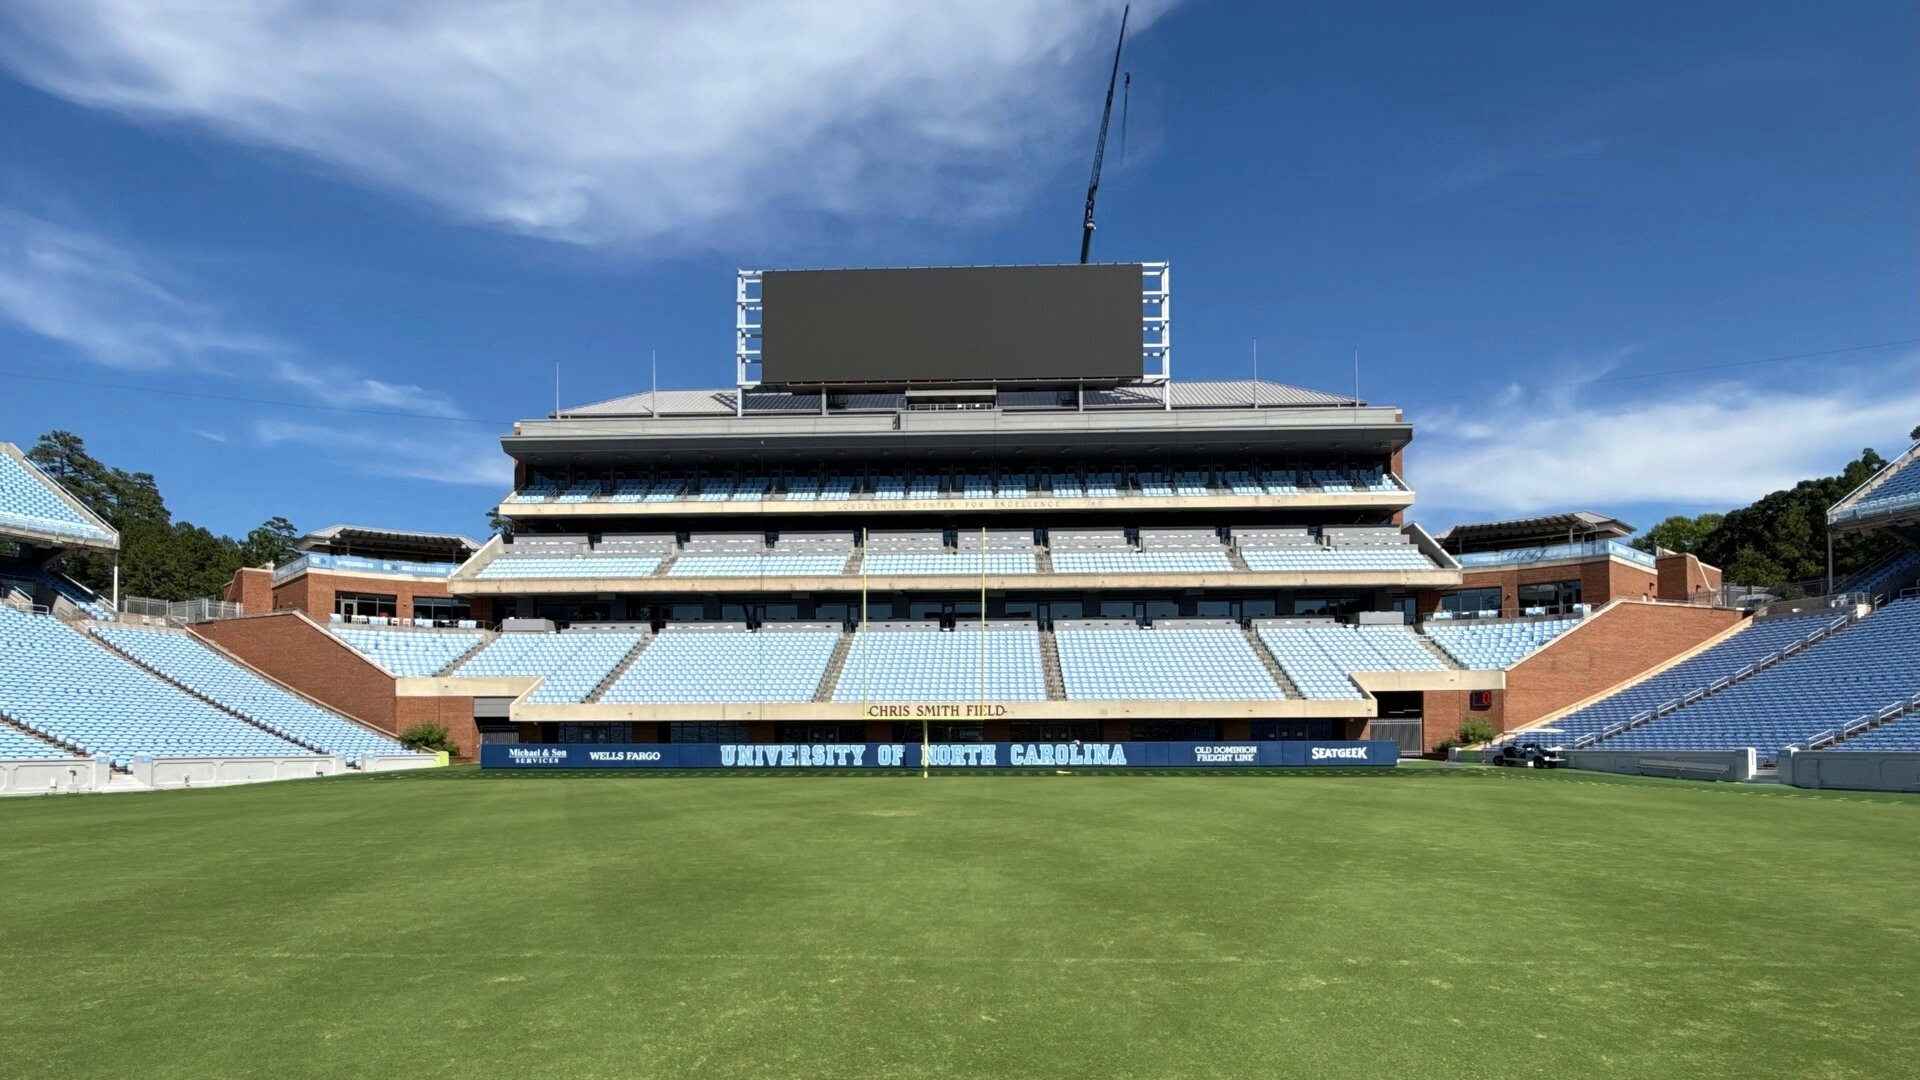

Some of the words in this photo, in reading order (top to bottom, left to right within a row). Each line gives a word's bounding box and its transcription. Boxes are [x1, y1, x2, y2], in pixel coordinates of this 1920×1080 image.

[869, 705, 910, 717] CHRIS
[916, 705, 960, 717] SMITH
[966, 705, 1005, 717] FIELD
[509, 748, 541, 757] Michael
[542, 749, 550, 757] &
[551, 749, 567, 757] Son
[1194, 746, 1212, 754] OLD
[1213, 746, 1257, 754] DOMINION
[1311, 747, 1367, 760] SEATGEEK
[589, 751, 624, 760] WELLS
[626, 751, 661, 760] FARGO
[720, 744, 866, 767] UNIVERSITY
[877, 744, 905, 767] OF
[921, 744, 996, 766] NORTH
[1010, 744, 1127, 766] CAROLINA
[1197, 753, 1233, 762] FREIGHT
[1234, 753, 1255, 762] LINE
